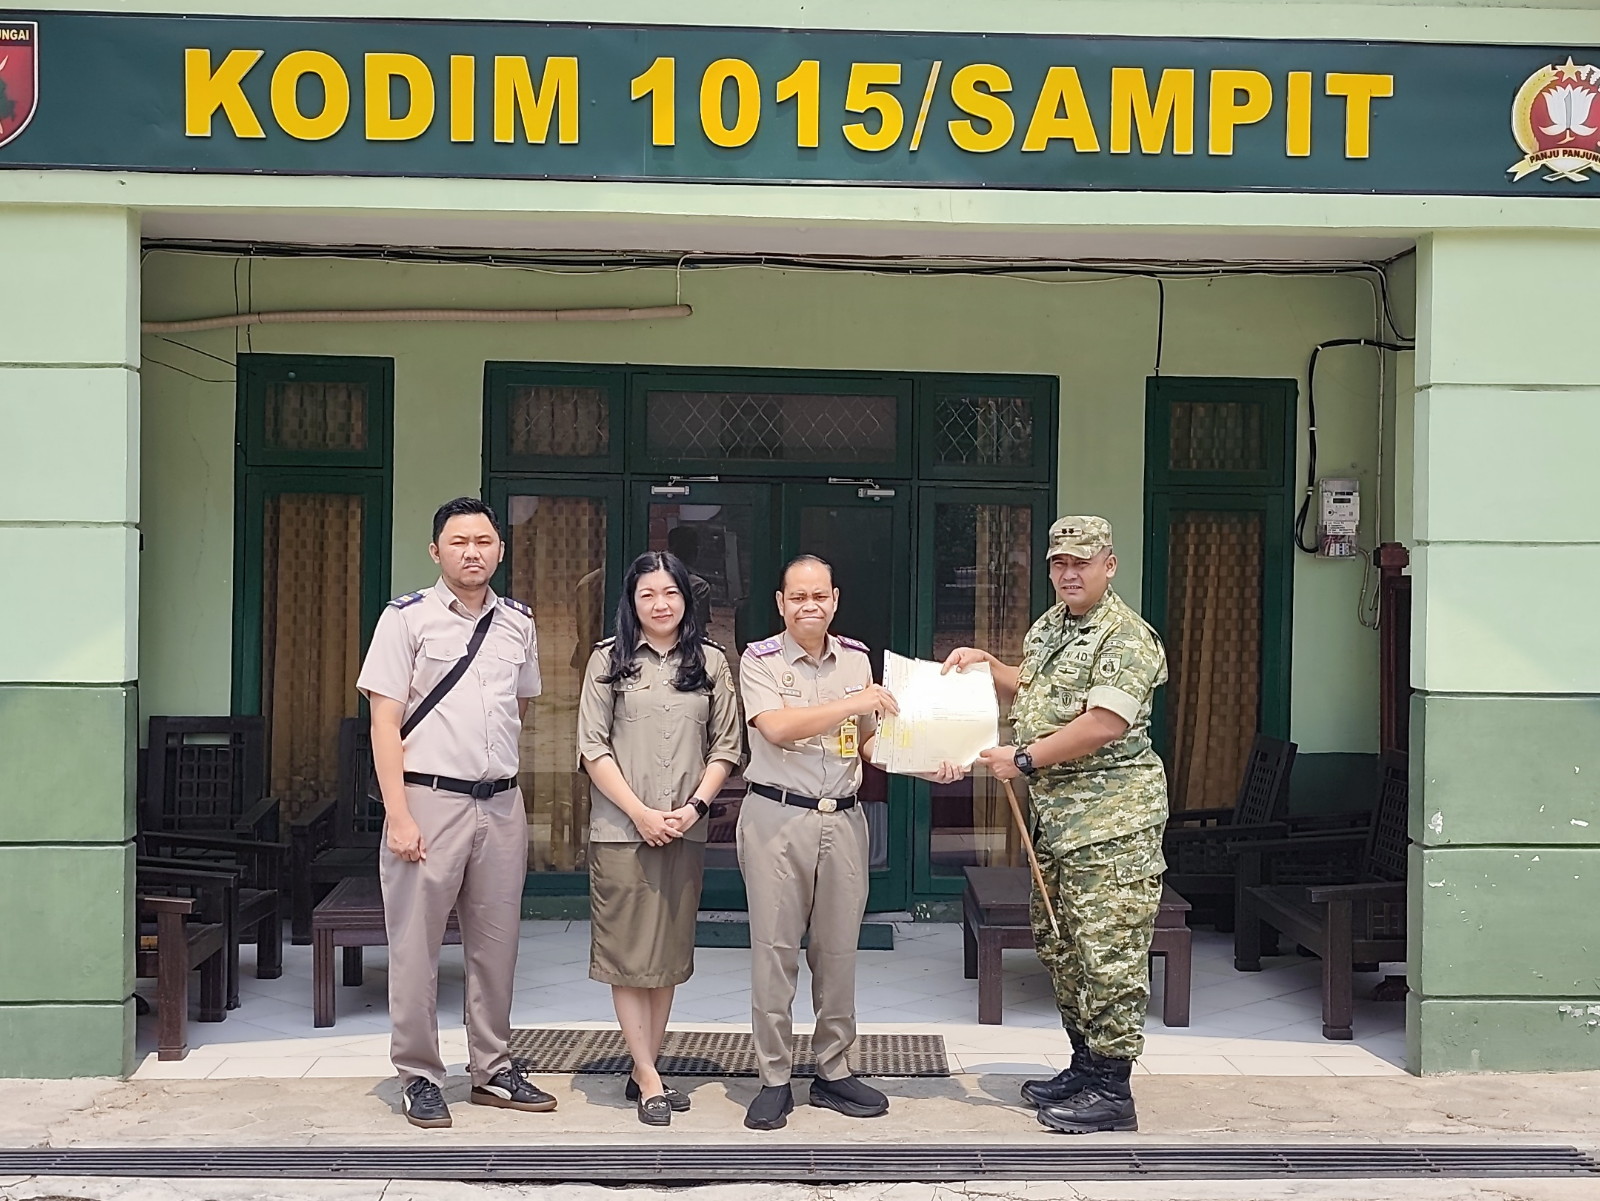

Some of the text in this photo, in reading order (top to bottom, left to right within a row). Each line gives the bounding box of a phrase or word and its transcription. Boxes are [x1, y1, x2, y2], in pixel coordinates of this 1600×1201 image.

[0, 29, 30, 41] NGAI
[184, 48, 1395, 160] KODIM 1015/SAMPIT
[1529, 150, 1600, 163] PANJU PANJUN
[1074, 652, 1087, 661] AD
